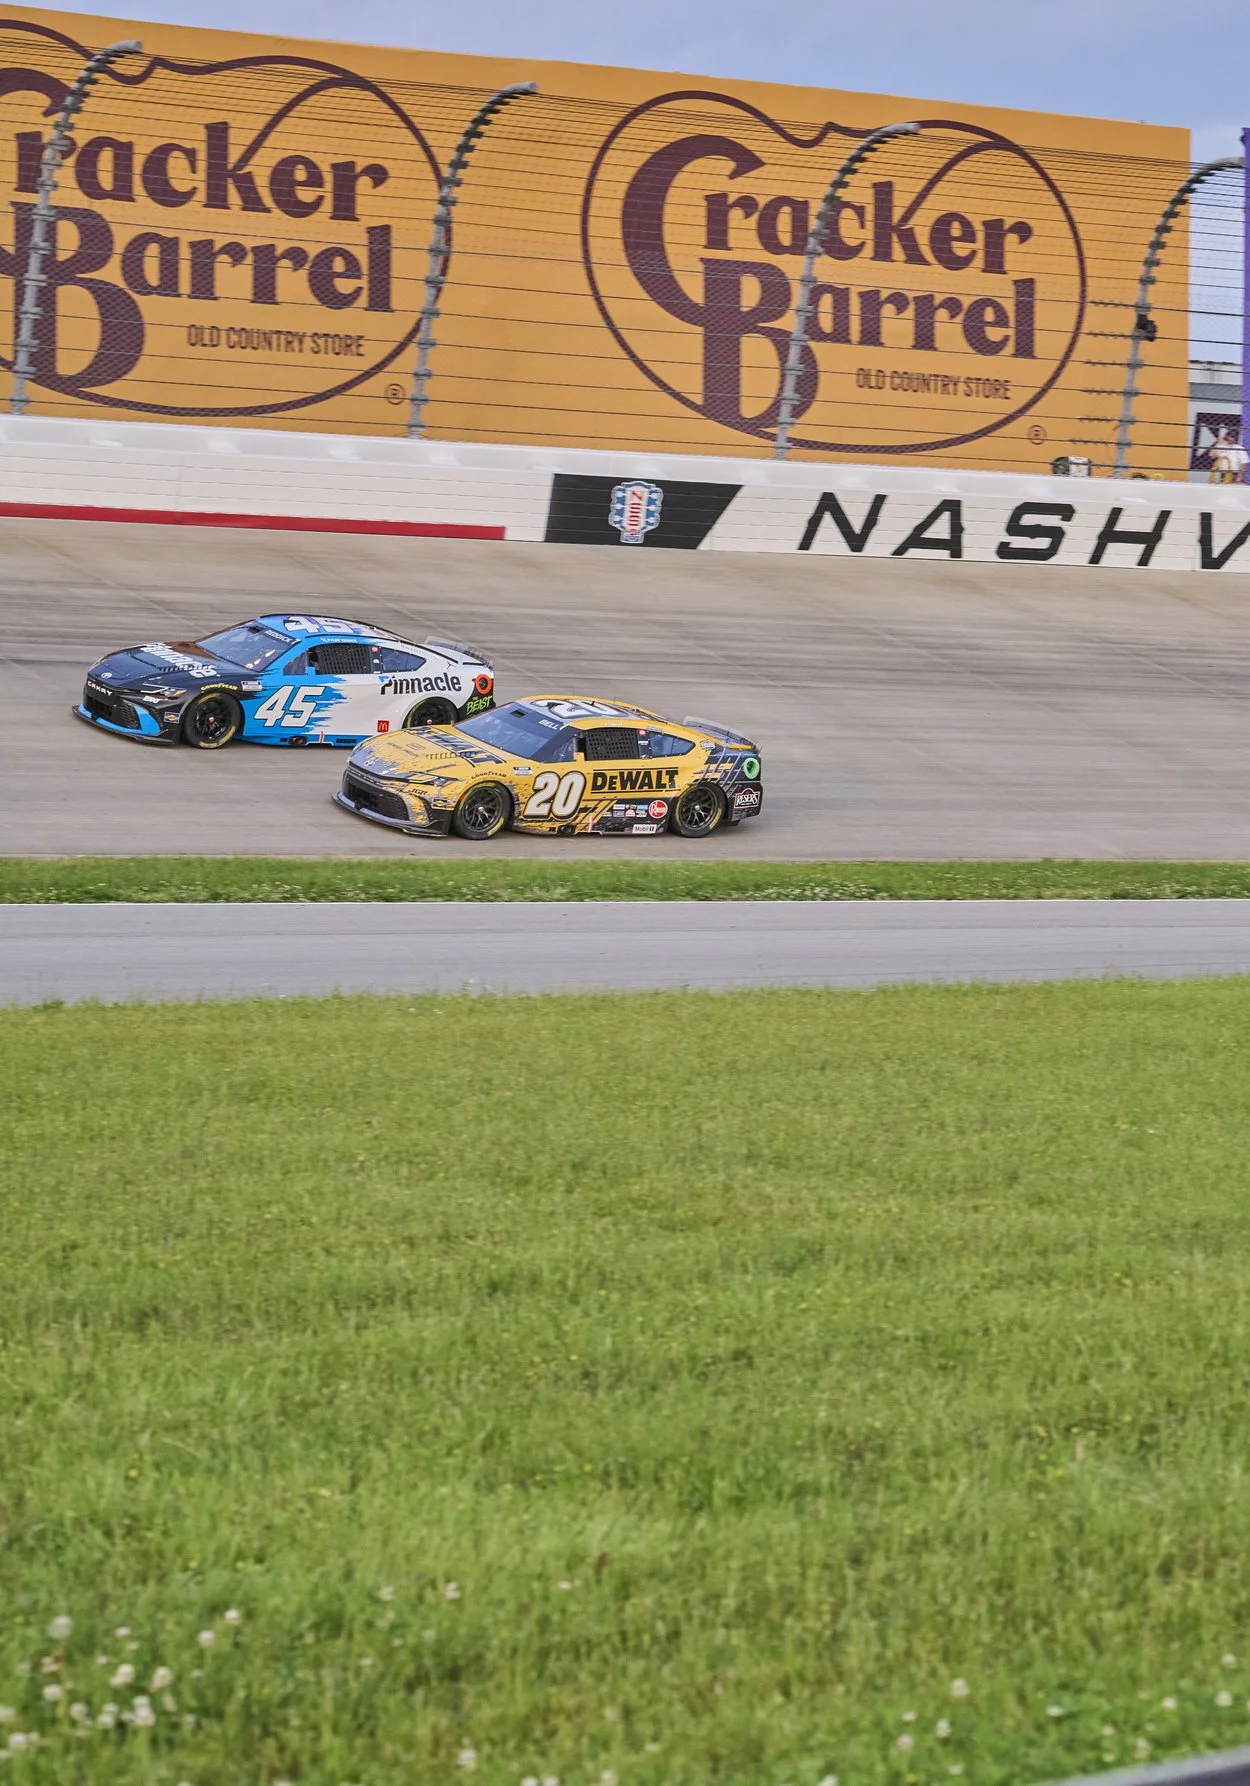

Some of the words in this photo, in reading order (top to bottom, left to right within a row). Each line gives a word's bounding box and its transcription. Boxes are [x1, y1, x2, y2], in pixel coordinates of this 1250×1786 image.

[622, 135, 1033, 328] Cracker
[13, 202, 393, 388] Barrel
[187, 324, 220, 348] OLD
[226, 327, 307, 353] COUNTRY
[310, 332, 365, 357] STORE
[700, 257, 1036, 433] Barrel
[856, 367, 886, 390] OLD
[890, 370, 961, 396] COUNTRY
[964, 376, 1012, 400] STORE
[87, 680, 113, 696] CAMRY
[379, 672, 462, 695] Pinnacle
[254, 684, 327, 728] 45
[466, 695, 493, 715] BEAST
[538, 719, 559, 730] BELL
[523, 771, 587, 820] 20
